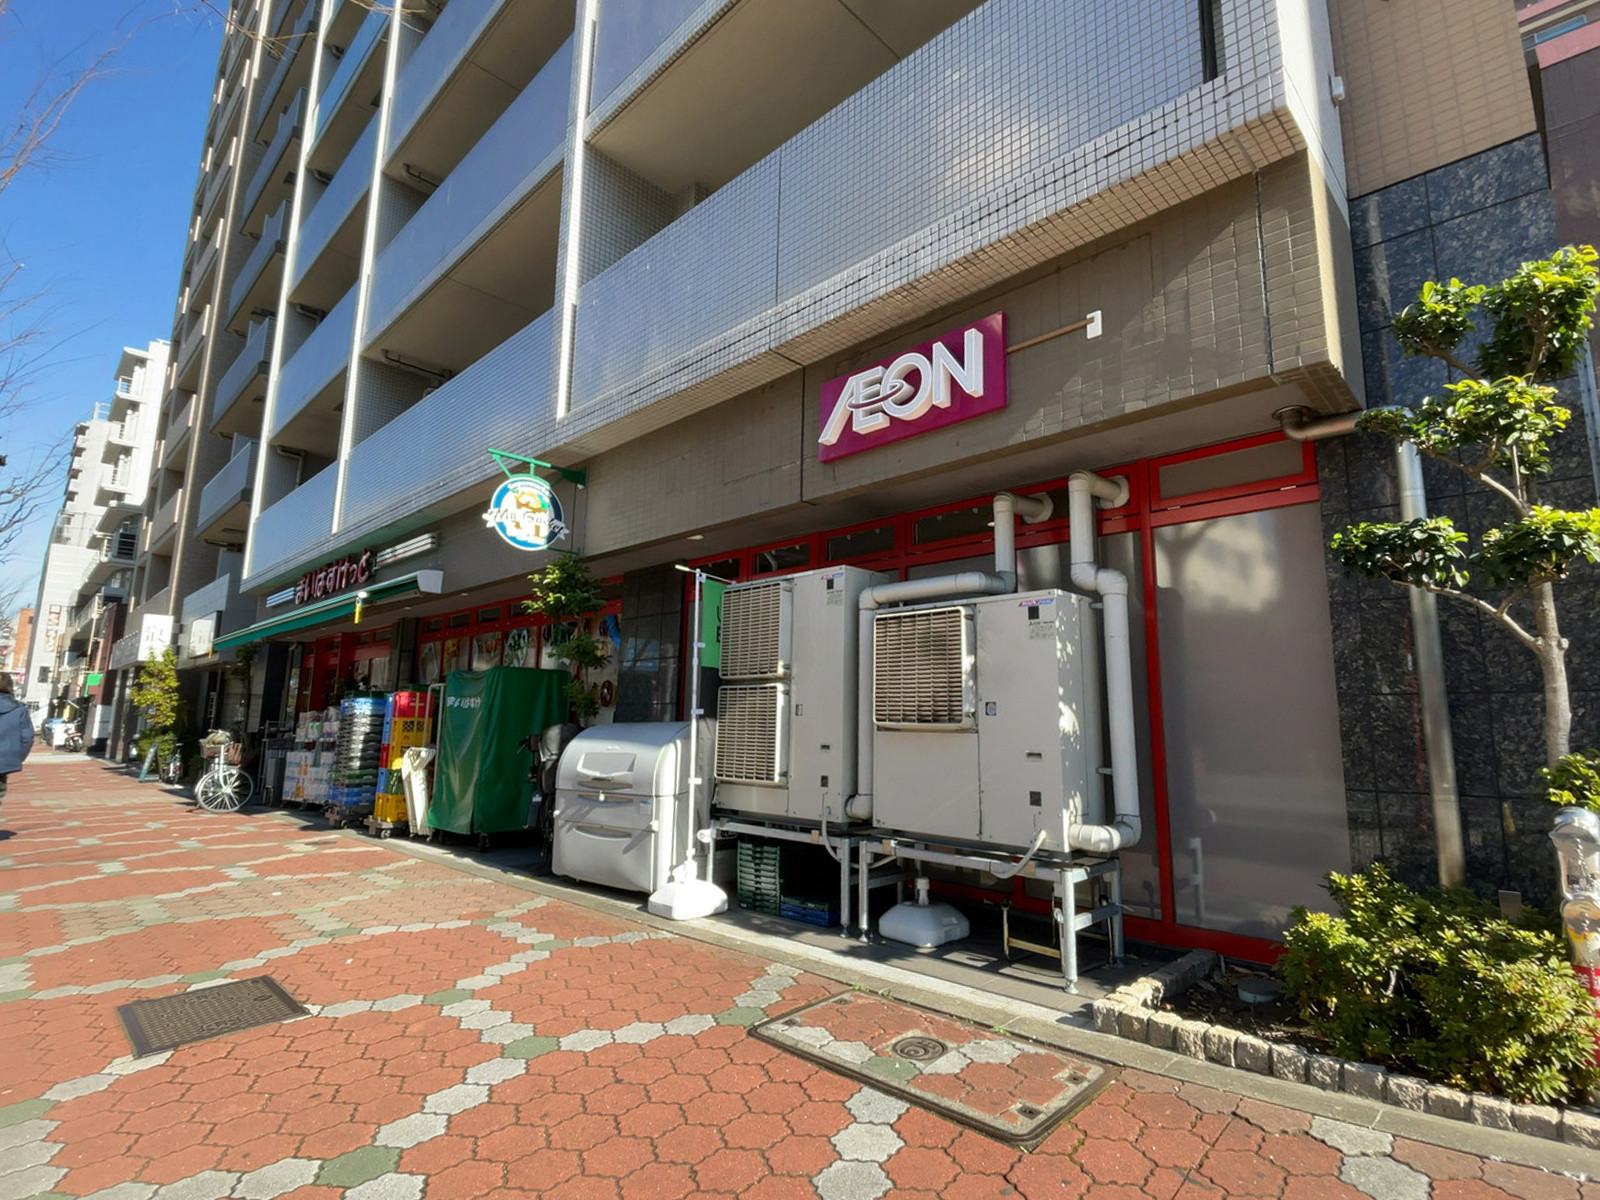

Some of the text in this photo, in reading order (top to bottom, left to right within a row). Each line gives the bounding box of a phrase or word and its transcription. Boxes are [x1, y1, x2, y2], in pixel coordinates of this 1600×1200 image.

[818, 328, 983, 446] AEON
[295, 549, 373, 605] まいばすけっと
